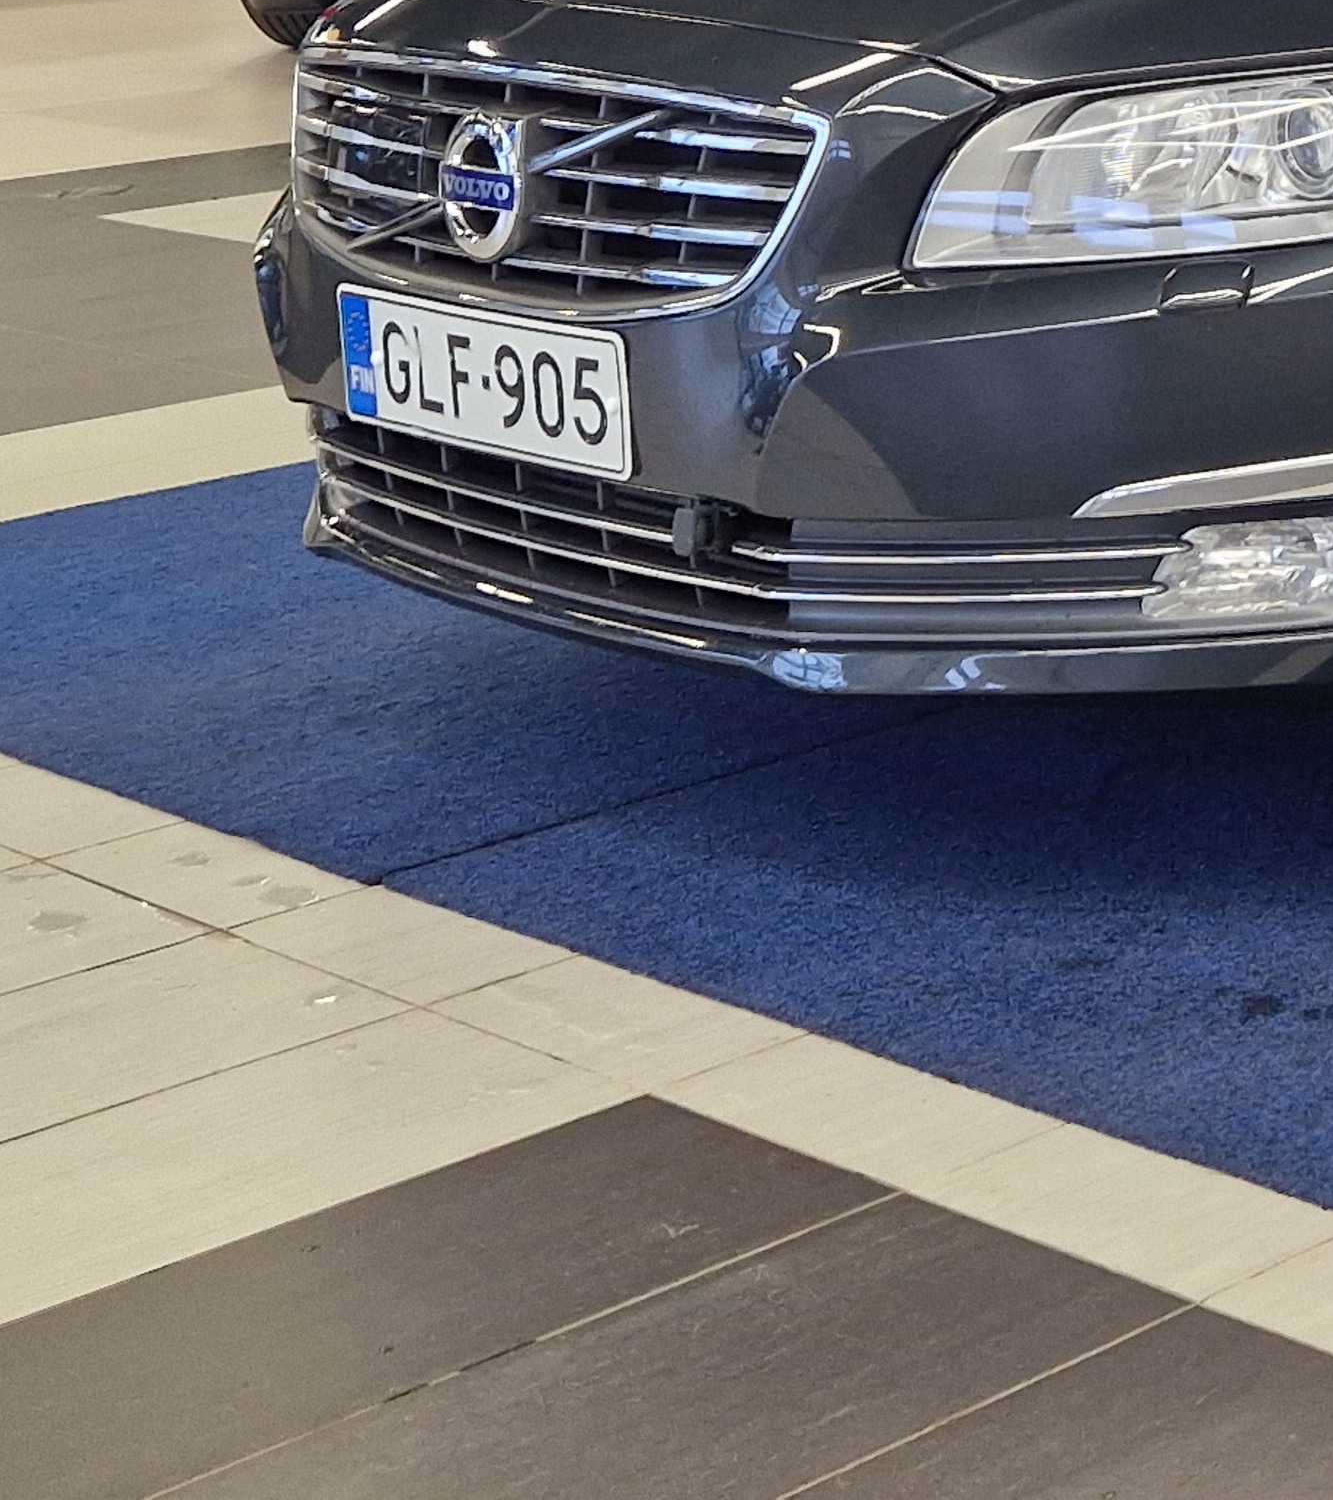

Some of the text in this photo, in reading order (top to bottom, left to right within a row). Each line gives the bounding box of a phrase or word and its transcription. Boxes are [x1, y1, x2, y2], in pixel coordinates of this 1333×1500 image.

[443, 173, 510, 201] VOLVO
[351, 365, 376, 394] FIN
[383, 321, 608, 445] GLF-905
